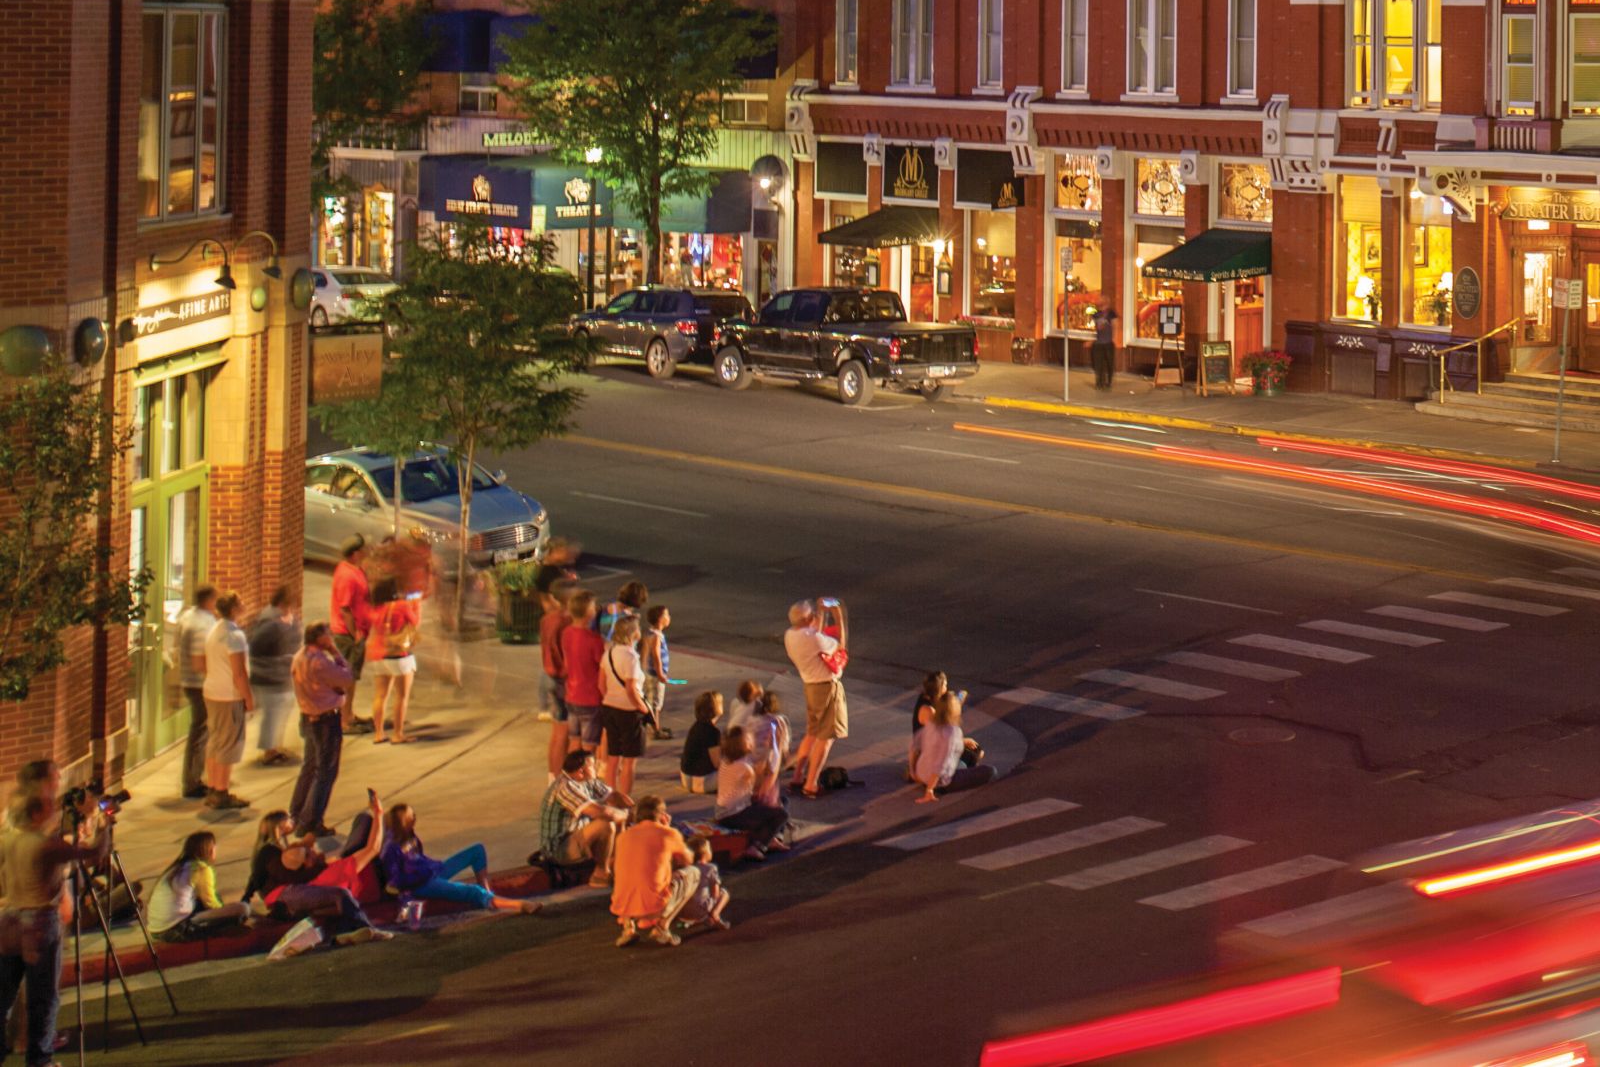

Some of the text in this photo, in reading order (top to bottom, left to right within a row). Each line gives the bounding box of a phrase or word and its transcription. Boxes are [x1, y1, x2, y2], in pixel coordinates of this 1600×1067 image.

[1554, 192, 1571, 204] The
[555, 204, 602, 219] THEATE
[1510, 202, 1570, 220] STRATER
[208, 293, 230, 314] ARTS
